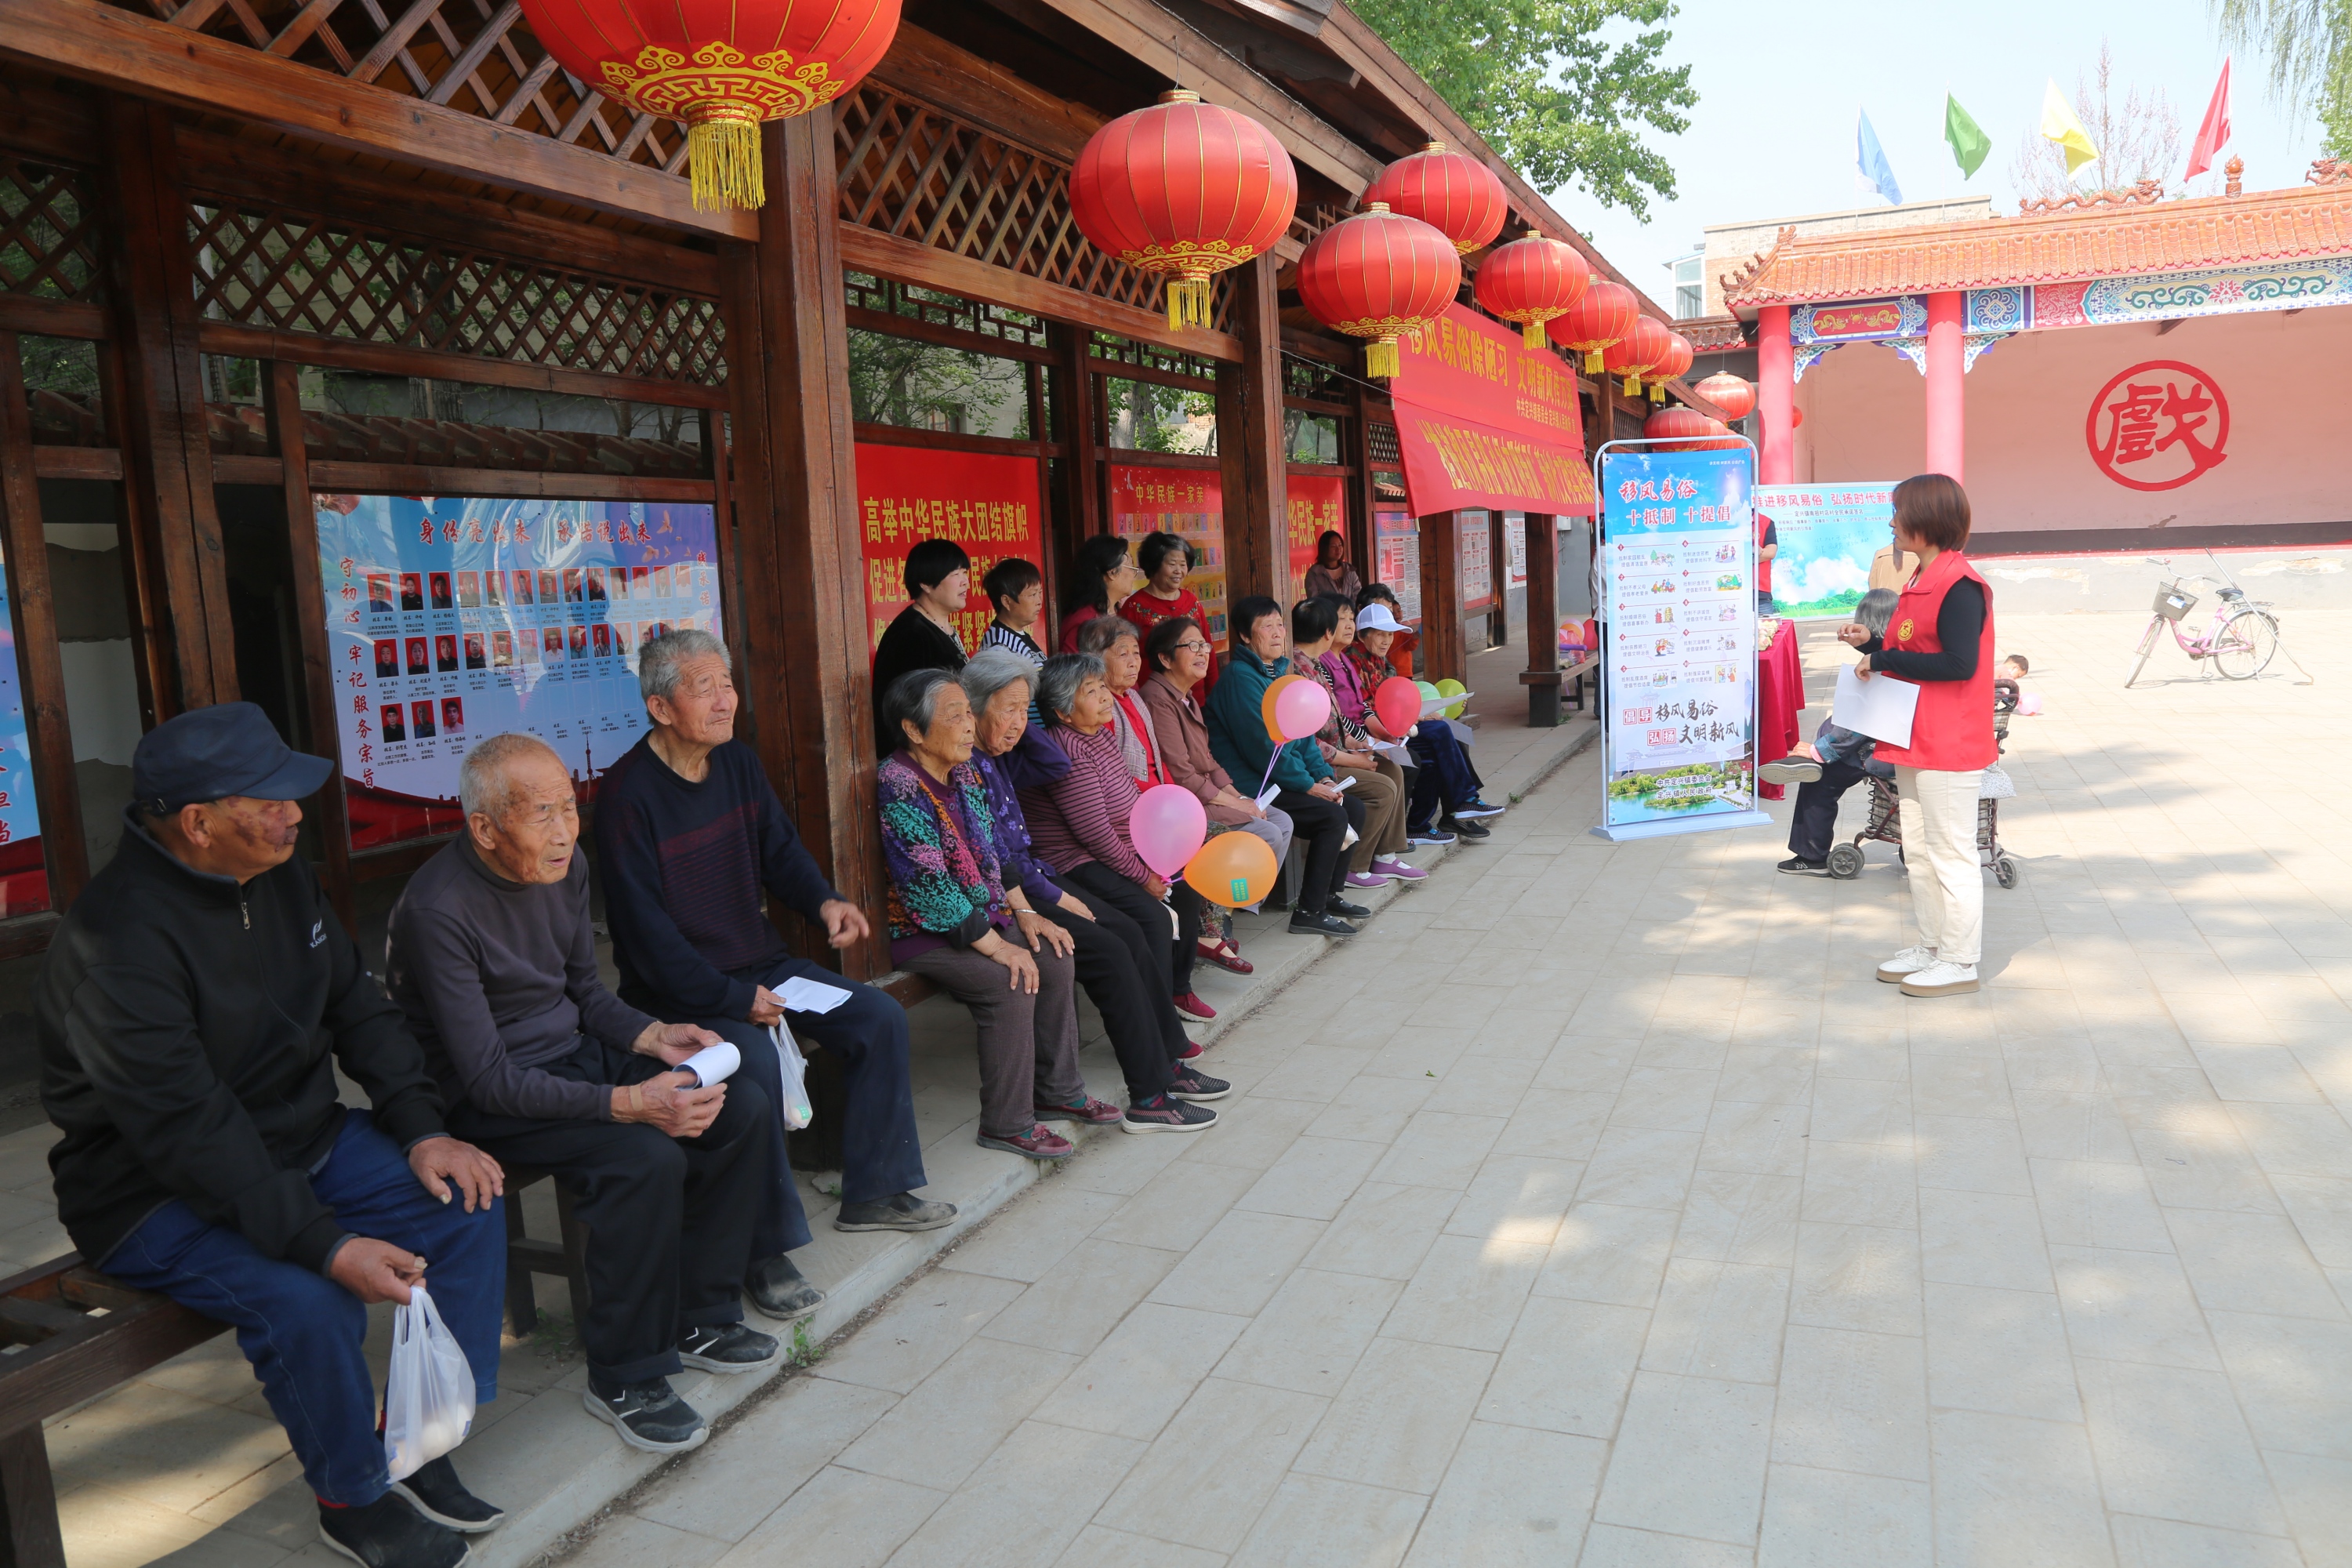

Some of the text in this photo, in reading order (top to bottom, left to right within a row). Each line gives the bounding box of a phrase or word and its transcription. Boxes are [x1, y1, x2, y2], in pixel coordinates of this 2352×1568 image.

[1135, 483, 1204, 504] 中华民族一家亲
[1618, 478, 1698, 504] 移风易俗
[863, 496, 1029, 543] 高举中华民族大团结旗帜
[1626, 505, 1731, 526] 十抵制 十提倡
[419, 517, 652, 545] 身份亮出来 承诺说出来
[340, 557, 361, 624] 守初心
[348, 644, 375, 789] 牢记服务宗旨
[1624, 699, 1719, 724] 倡导 移风易俗
[1647, 720, 1740, 746] 弘扬 文明新风
[1657, 775, 1712, 787] 中共定兴镇委员会
[1657, 787, 1713, 800] 定兴镇人民政府
